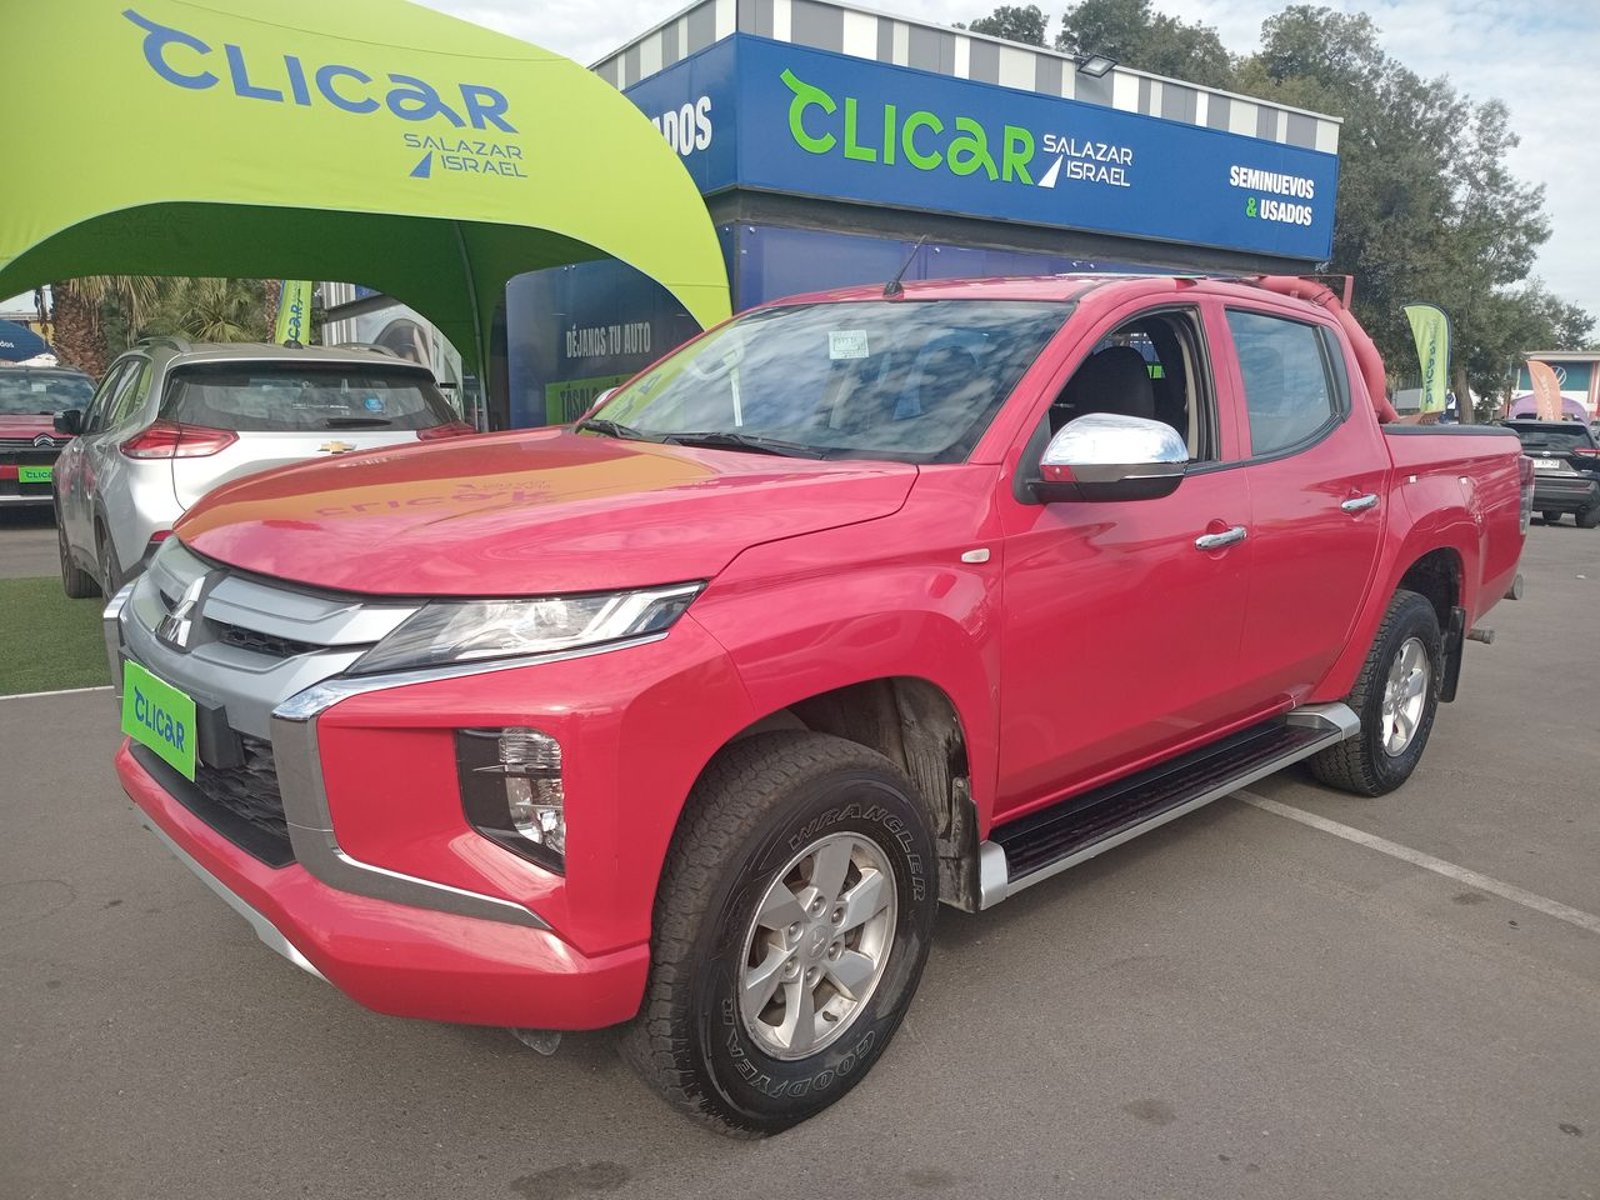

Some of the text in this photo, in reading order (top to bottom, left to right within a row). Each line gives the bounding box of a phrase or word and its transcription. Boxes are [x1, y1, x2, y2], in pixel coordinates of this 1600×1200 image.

[651, 95, 713, 157] DOS
[403, 133, 523, 160] SALAZAR
[1042, 133, 1133, 167] SALAZAR
[440, 154, 529, 178] ISRAEL
[1066, 159, 1131, 187] ISRAEL
[1229, 165, 1315, 200] SEMINUEVOS
[1245, 197, 1313, 226] & USADOS
[566, 321, 651, 359] DÉJANOS TU AUTO
[789, 802, 928, 904] WRANGLER
